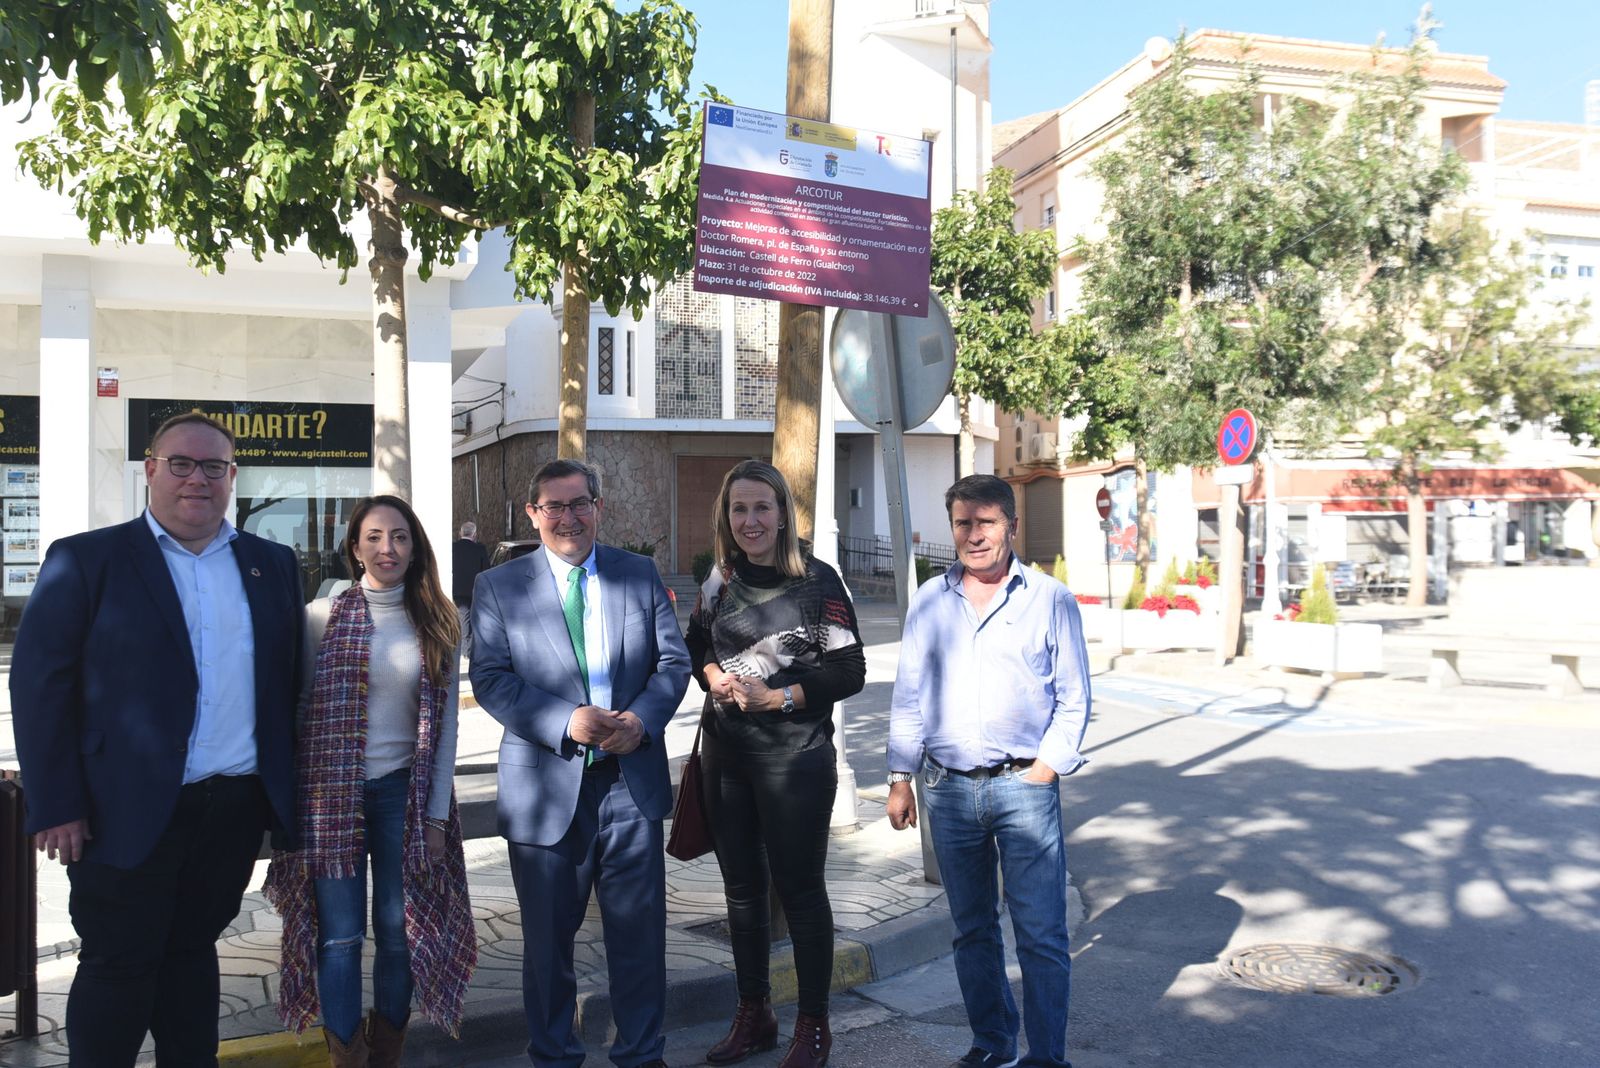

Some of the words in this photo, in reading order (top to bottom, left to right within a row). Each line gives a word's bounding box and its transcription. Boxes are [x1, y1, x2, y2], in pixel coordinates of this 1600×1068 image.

[736, 111, 763, 119] Financiado
[795, 186, 843, 200] ARCOTUR
[735, 199, 766, 207] Actuaciones
[767, 203, 793, 212] especiales
[750, 193, 798, 204] modernización
[803, 201, 851, 214] competitividad
[883, 213, 910, 221] turístico.
[701, 217, 744, 230] Proyecto:
[746, 223, 777, 235] Mejoras
[779, 227, 790, 235] de
[791, 229, 841, 242] accesibilidad
[842, 237, 848, 245] y
[848, 237, 906, 251] ornamentación
[701, 231, 729, 241] Doctor
[731, 235, 765, 246] Romera,
[767, 239, 777, 249] pl.
[779, 241, 789, 249] de
[791, 243, 819, 254] España
[820, 248, 826, 256] y
[838, 250, 870, 260] entorno
[699, 259, 726, 269] Plazo:
[727, 263, 736, 271] 31
[739, 264, 750, 273] de
[751, 266, 783, 276] octubre
[785, 270, 795, 278] de
[797, 272, 817, 281] 2022
[700, 245, 746, 257] Ubicación:
[750, 252, 777, 261] Castell
[778, 255, 789, 263] de
[791, 257, 812, 266] Ferro
[813, 260, 855, 272] (Gualchos)
[698, 274, 737, 286] Importe
[749, 280, 803, 295] adjudicación
[805, 287, 822, 297] (IVA
[863, 294, 901, 305] 38.146,39
[272, 449, 368, 458] www.agicastell.com
